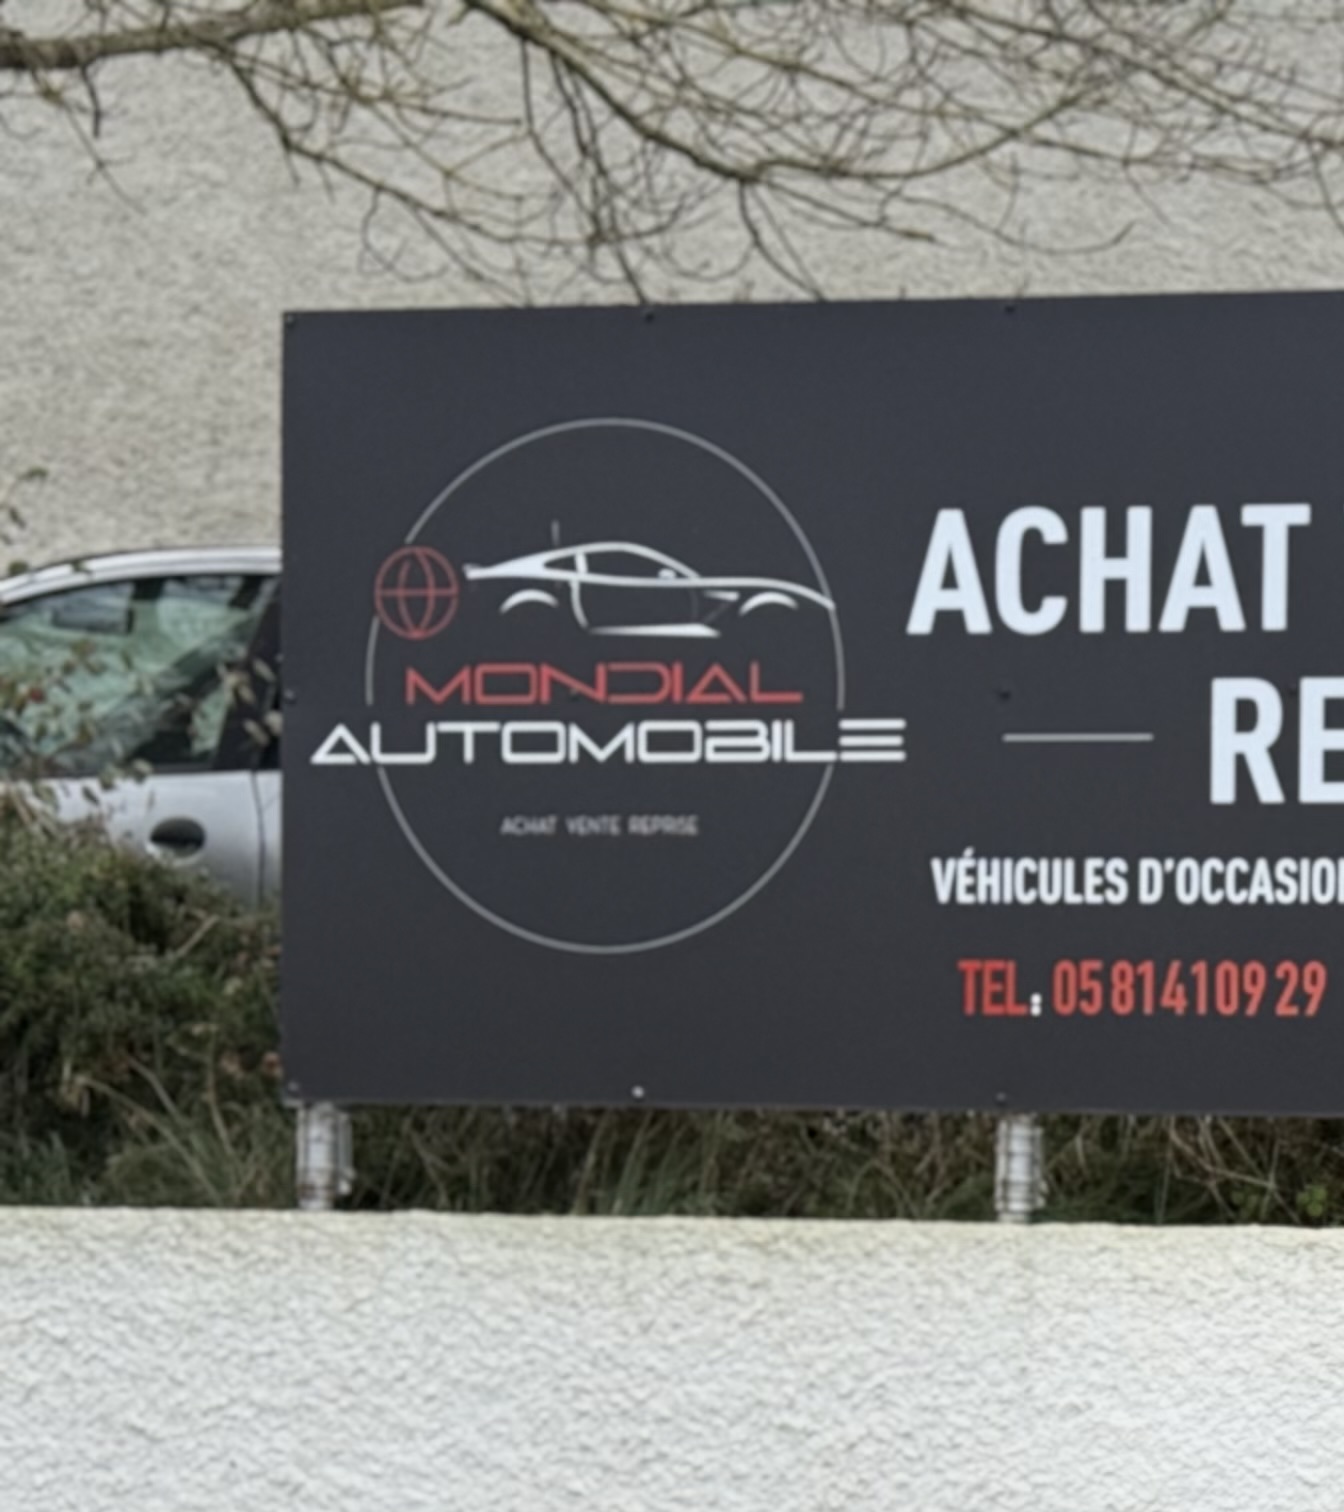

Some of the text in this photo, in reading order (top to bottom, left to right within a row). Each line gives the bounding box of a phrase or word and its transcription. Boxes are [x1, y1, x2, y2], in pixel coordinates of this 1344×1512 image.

[907, 502, 1311, 635] ACHAT
[406, 661, 803, 704] MONDIAL
[310, 719, 906, 765] AUTOMOBILE
[500, 814, 557, 836] ACHAT
[564, 814, 622, 836] VENTE
[931, 846, 1130, 905] VÉHICULES
